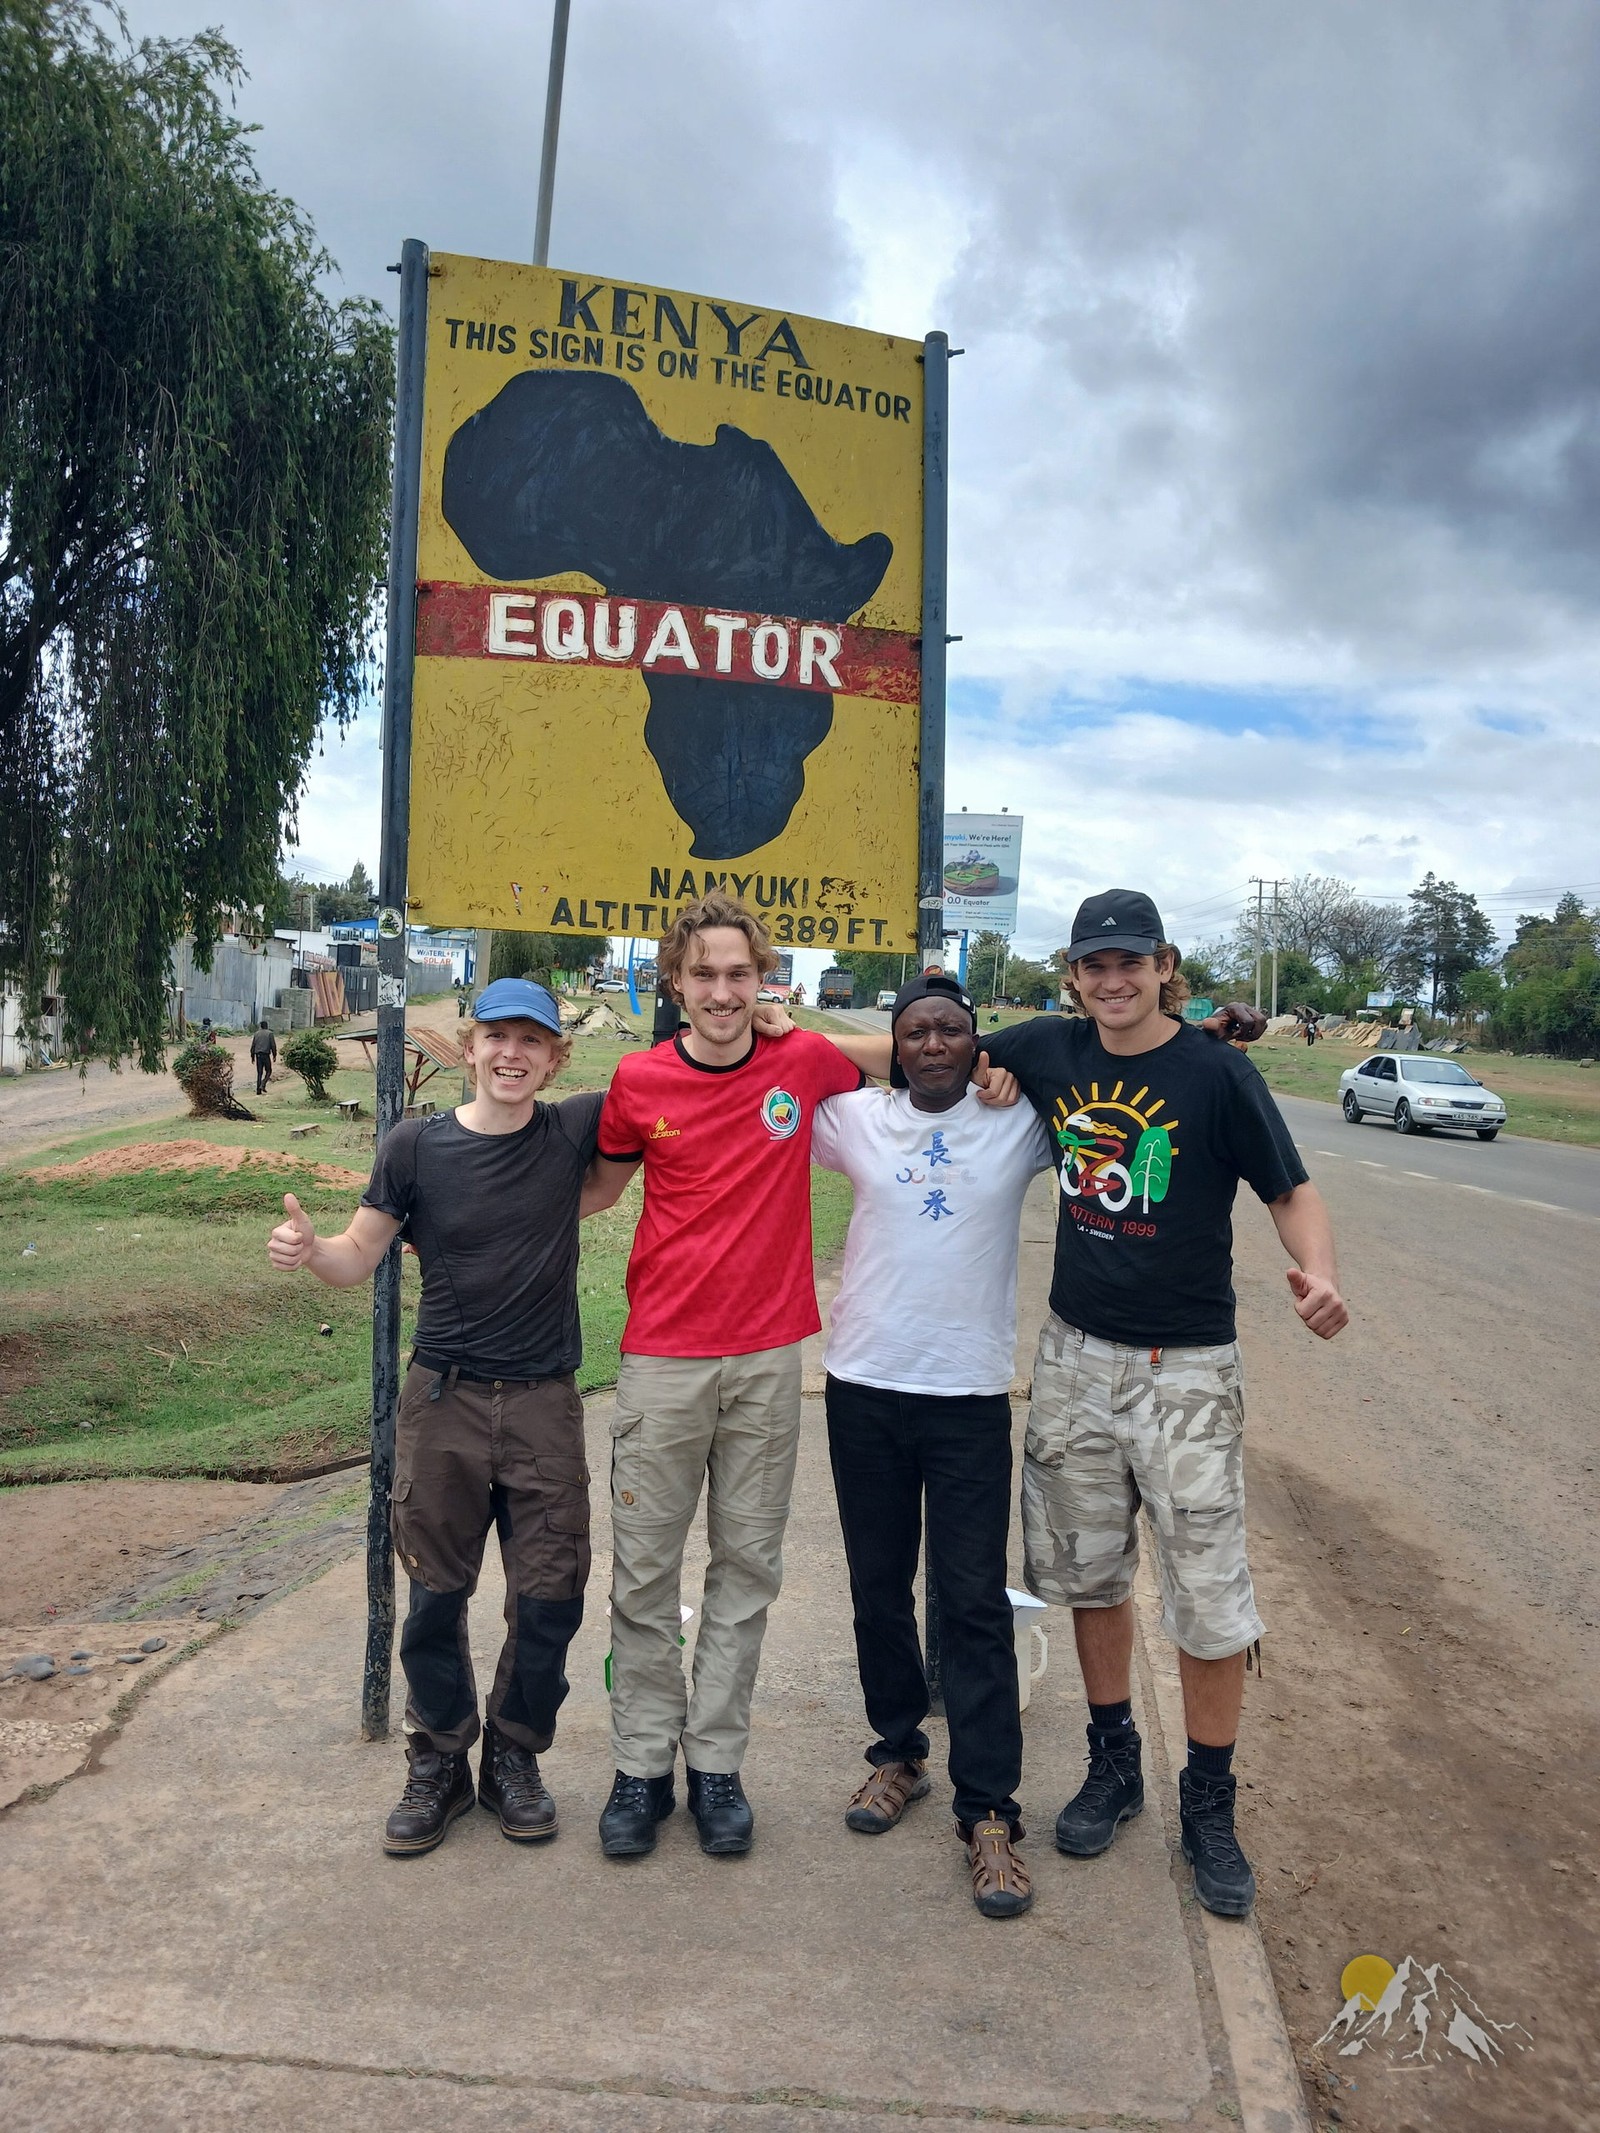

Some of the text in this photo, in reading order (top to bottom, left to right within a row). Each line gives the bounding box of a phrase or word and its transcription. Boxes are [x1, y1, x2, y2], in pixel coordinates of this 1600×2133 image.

[557, 278, 815, 370] KENYA
[445, 319, 912, 424] THIS SIGN IS ON THE EQUATOR
[488, 592, 844, 688] EQUATOR
[649, 866, 809, 909] NANYUKI
[963, 898, 990, 907] Equator
[550, 897, 686, 933] ALTITU
[847, 917, 894, 948] FT.
[423, 957, 452, 965] SOLAR
[1089, 1228, 1115, 1241] SWEDEN
[1122, 1221, 1157, 1237] 1999
